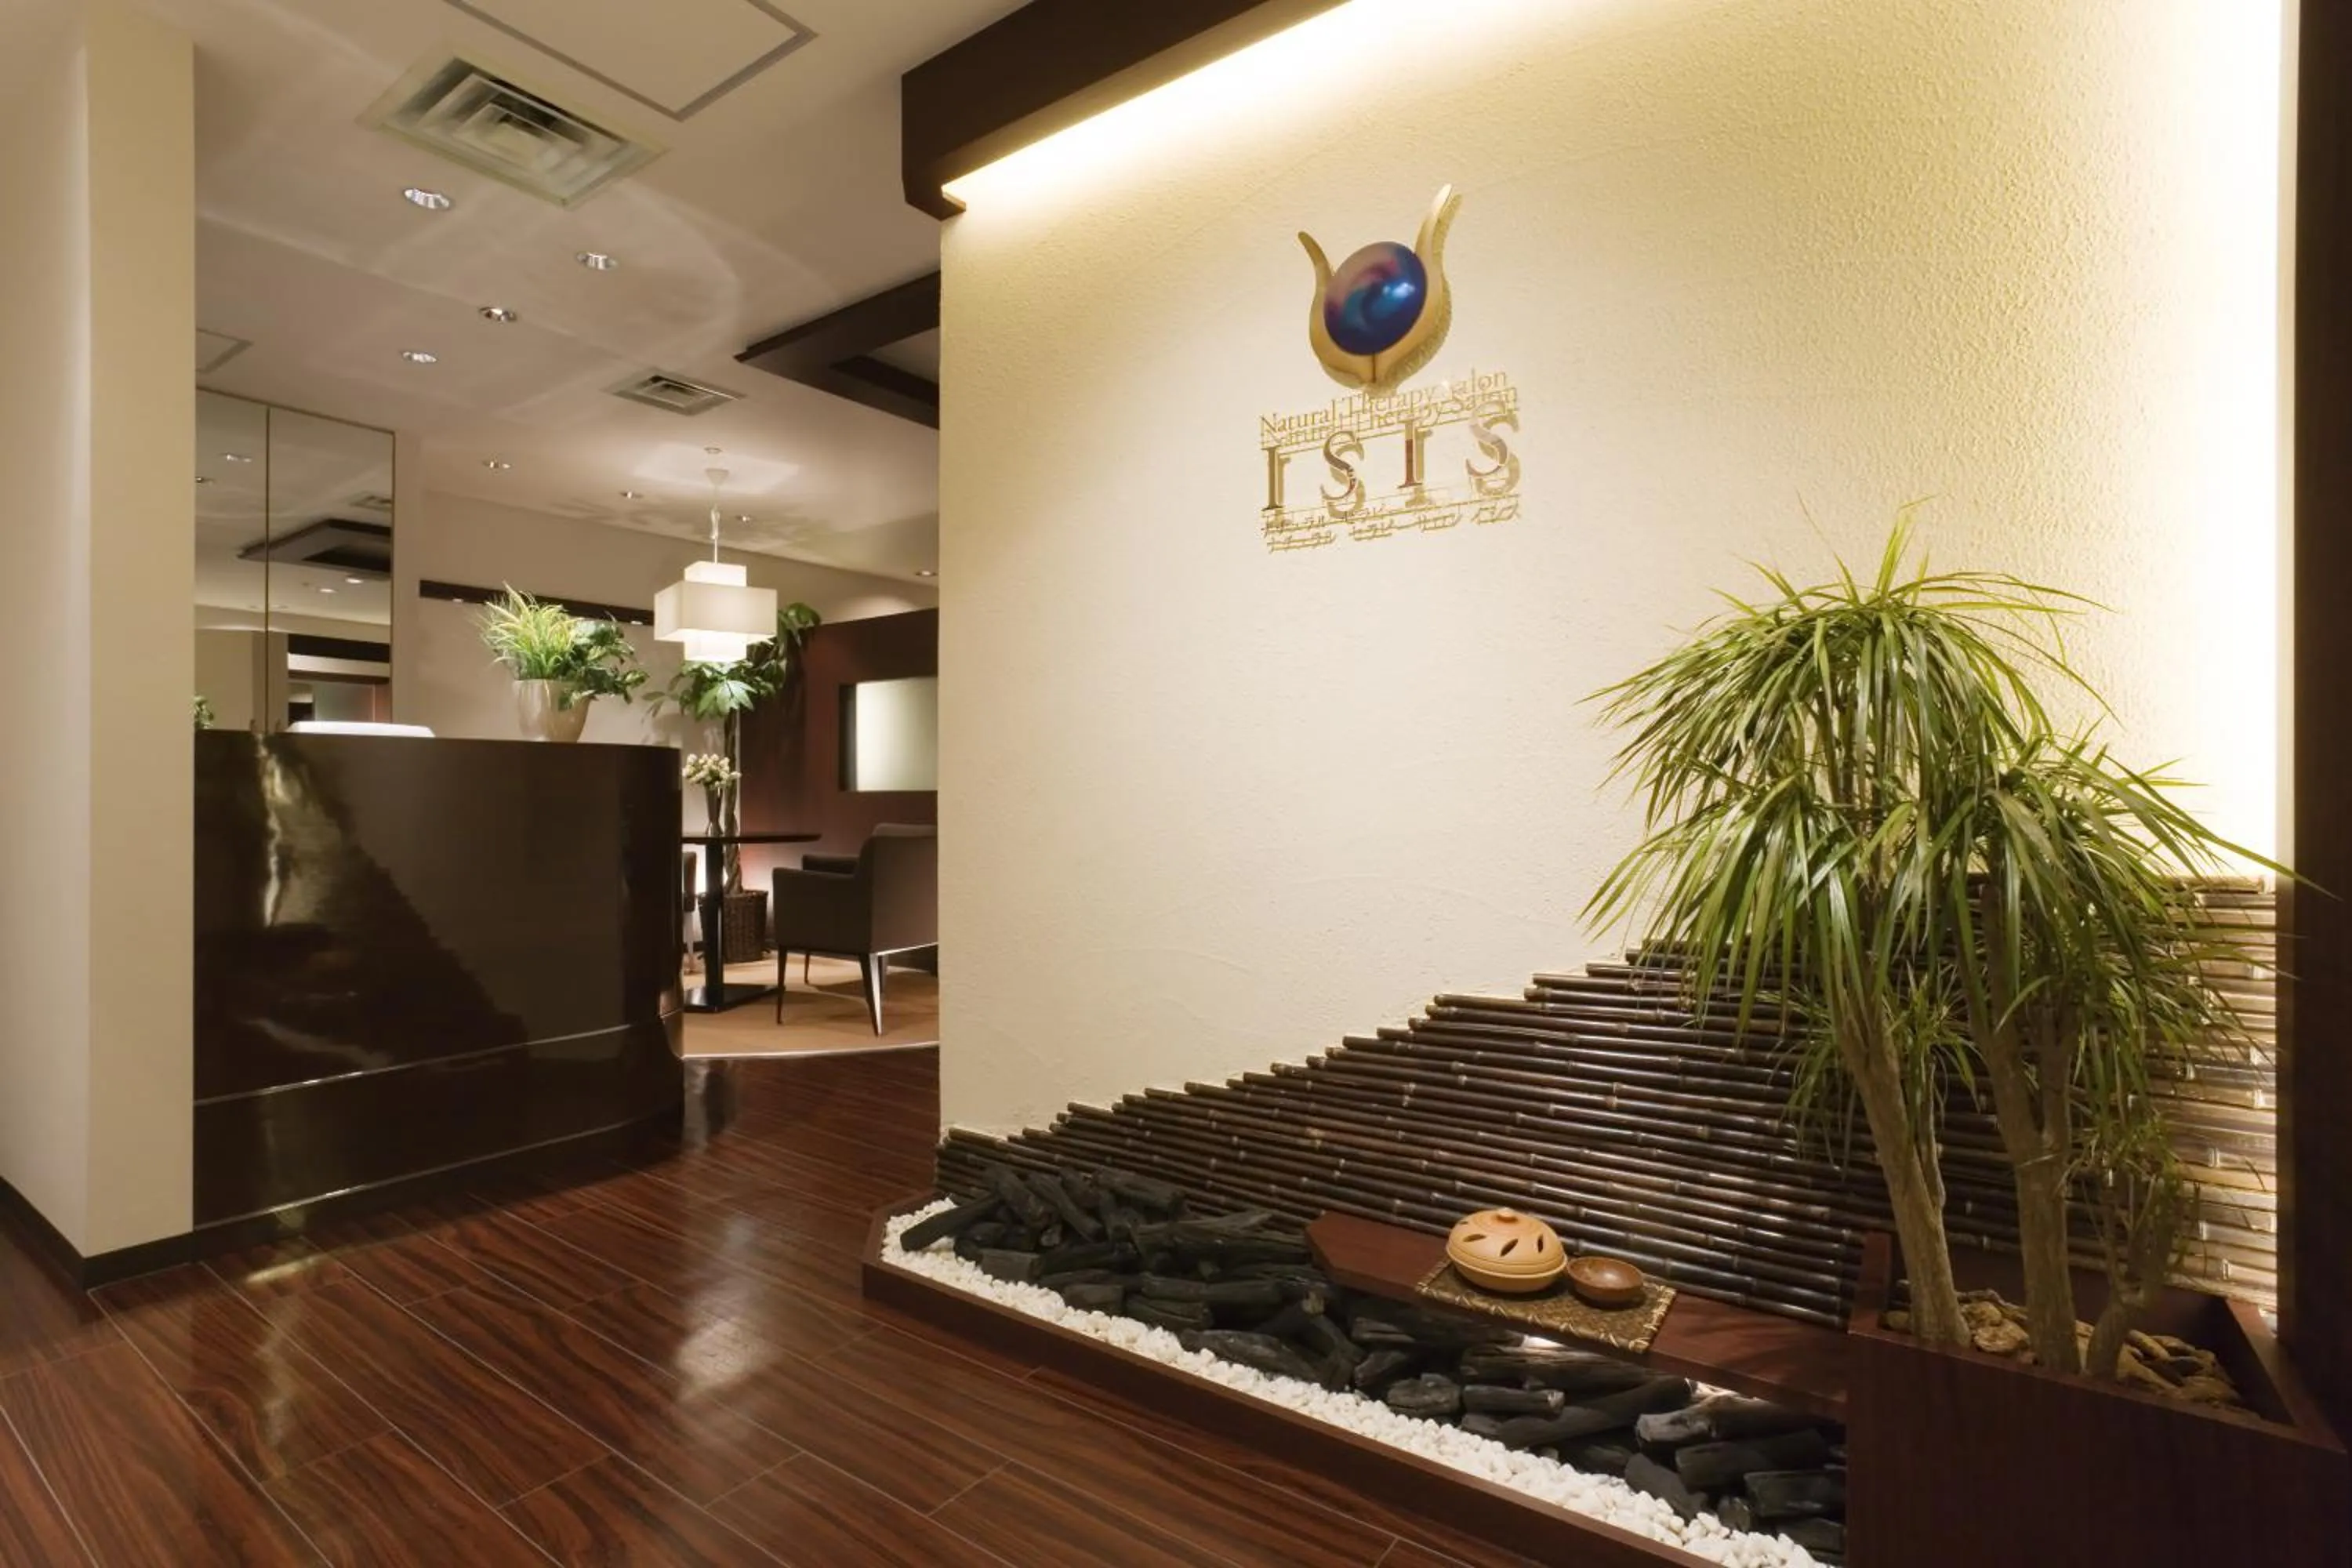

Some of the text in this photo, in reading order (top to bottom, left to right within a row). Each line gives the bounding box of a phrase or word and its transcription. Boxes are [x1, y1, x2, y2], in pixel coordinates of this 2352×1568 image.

[1261, 399, 1337, 434] Natural
[1341, 386, 1436, 417] Therapy
[1261, 401, 1509, 511] ISIS
